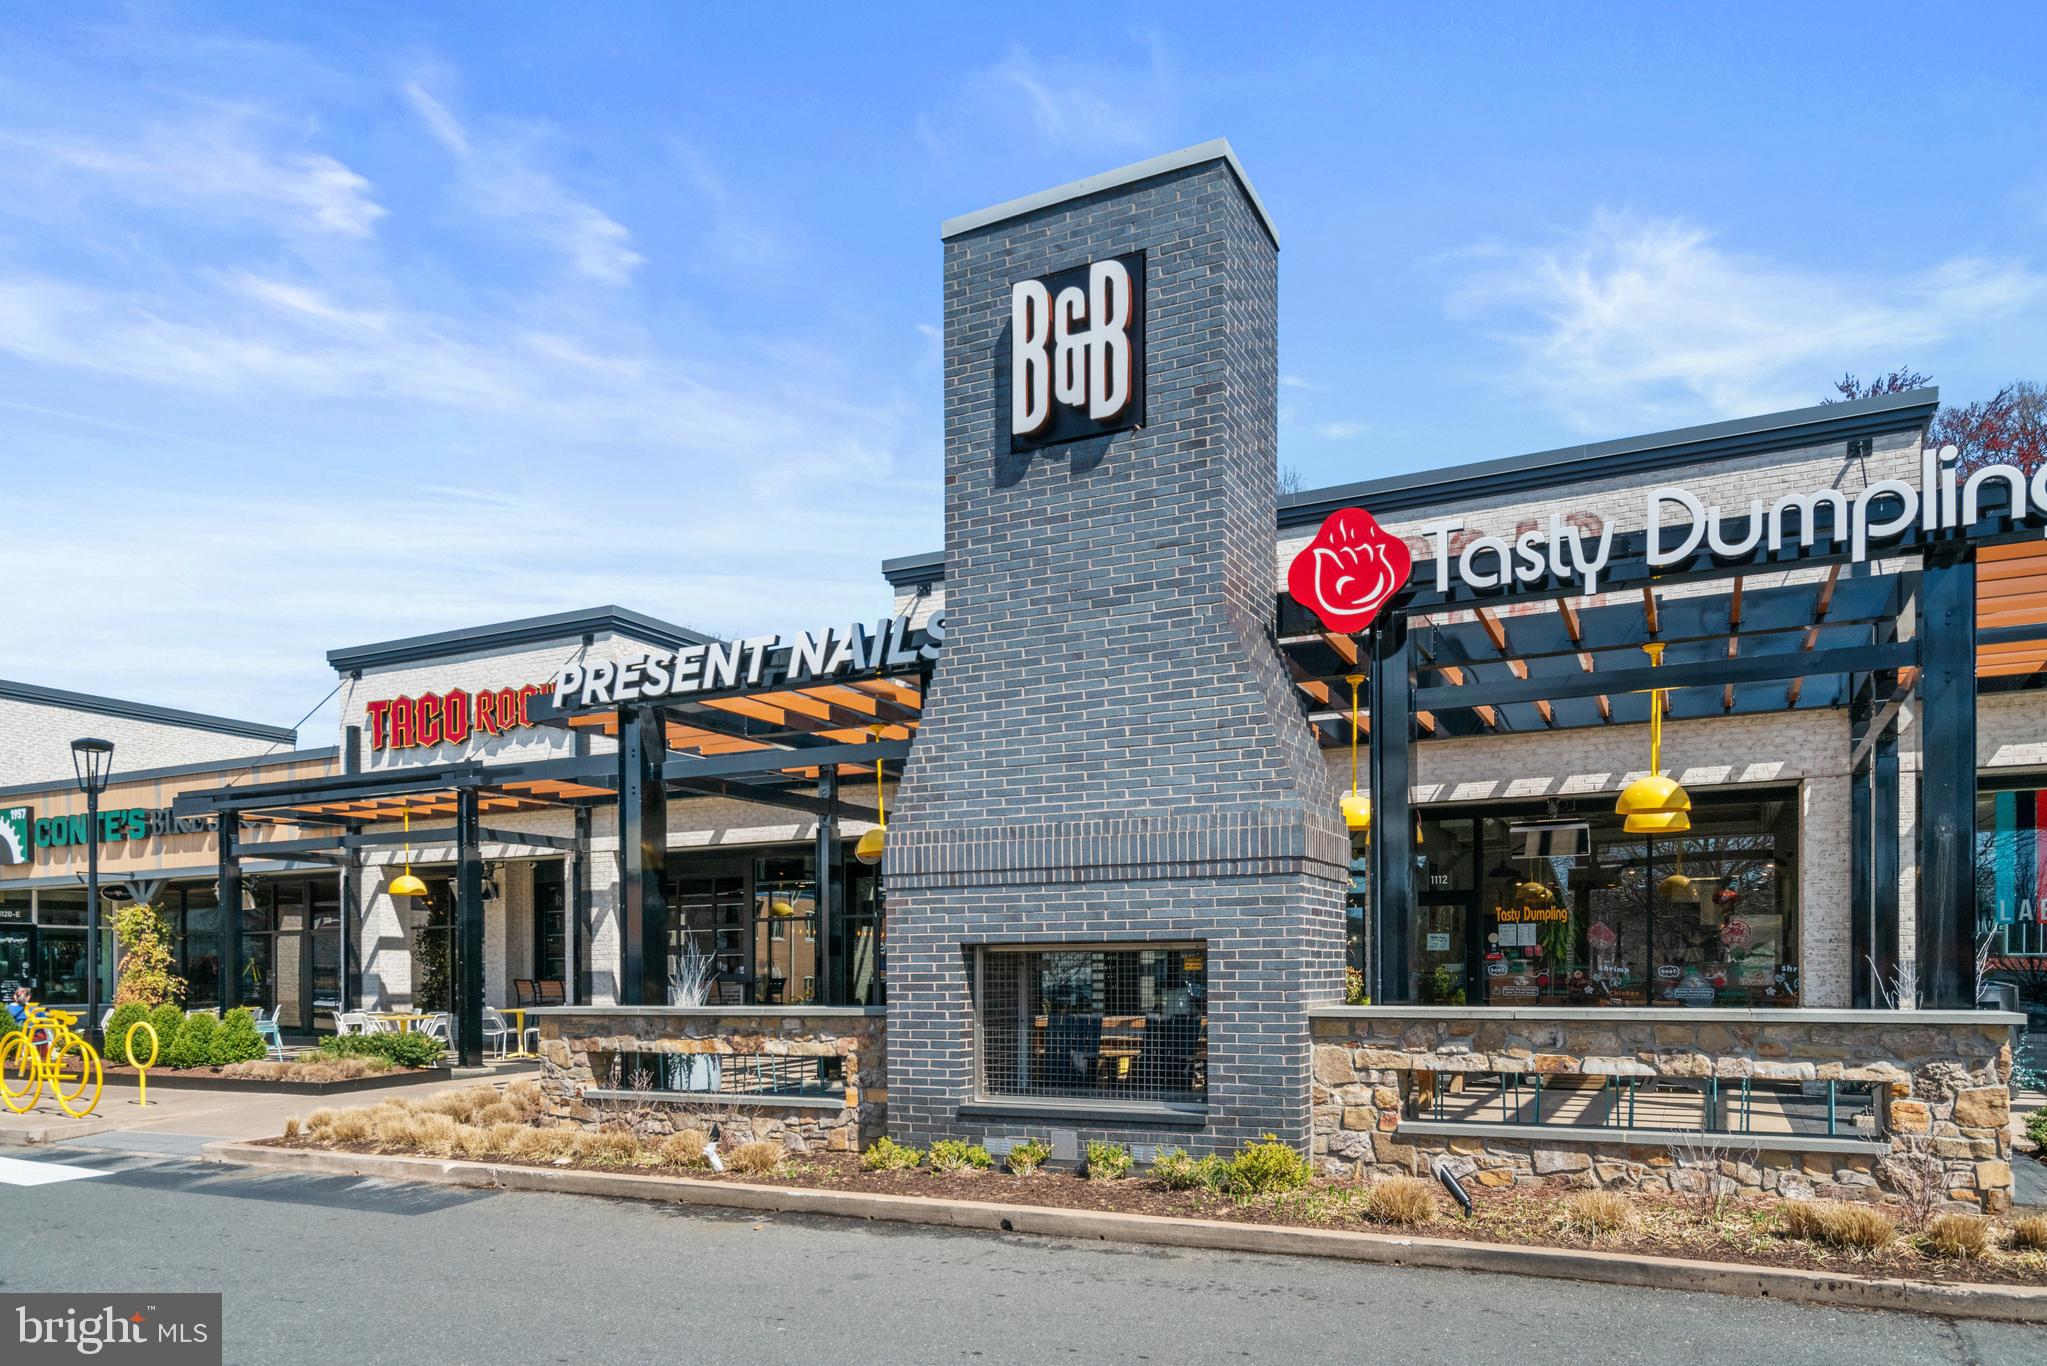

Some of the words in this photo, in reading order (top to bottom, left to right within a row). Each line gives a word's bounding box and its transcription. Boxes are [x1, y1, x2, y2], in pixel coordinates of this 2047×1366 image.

[1012, 259, 1132, 434] B&B
[1421, 509, 1616, 595] Tasty
[1646, 444, 2047, 566] Dumplin
[551, 634, 780, 709] PRESENT
[786, 609, 947, 679] NAILS
[366, 687, 472, 752] TACO
[474, 680, 557, 737] ROC
[10, 808, 27, 821] 1957
[1430, 875, 1448, 885] 1112
[1495, 906, 1521, 924] Tasty
[1523, 905, 1569, 923] Dumpling
[1599, 965, 1630, 974] shrimp
